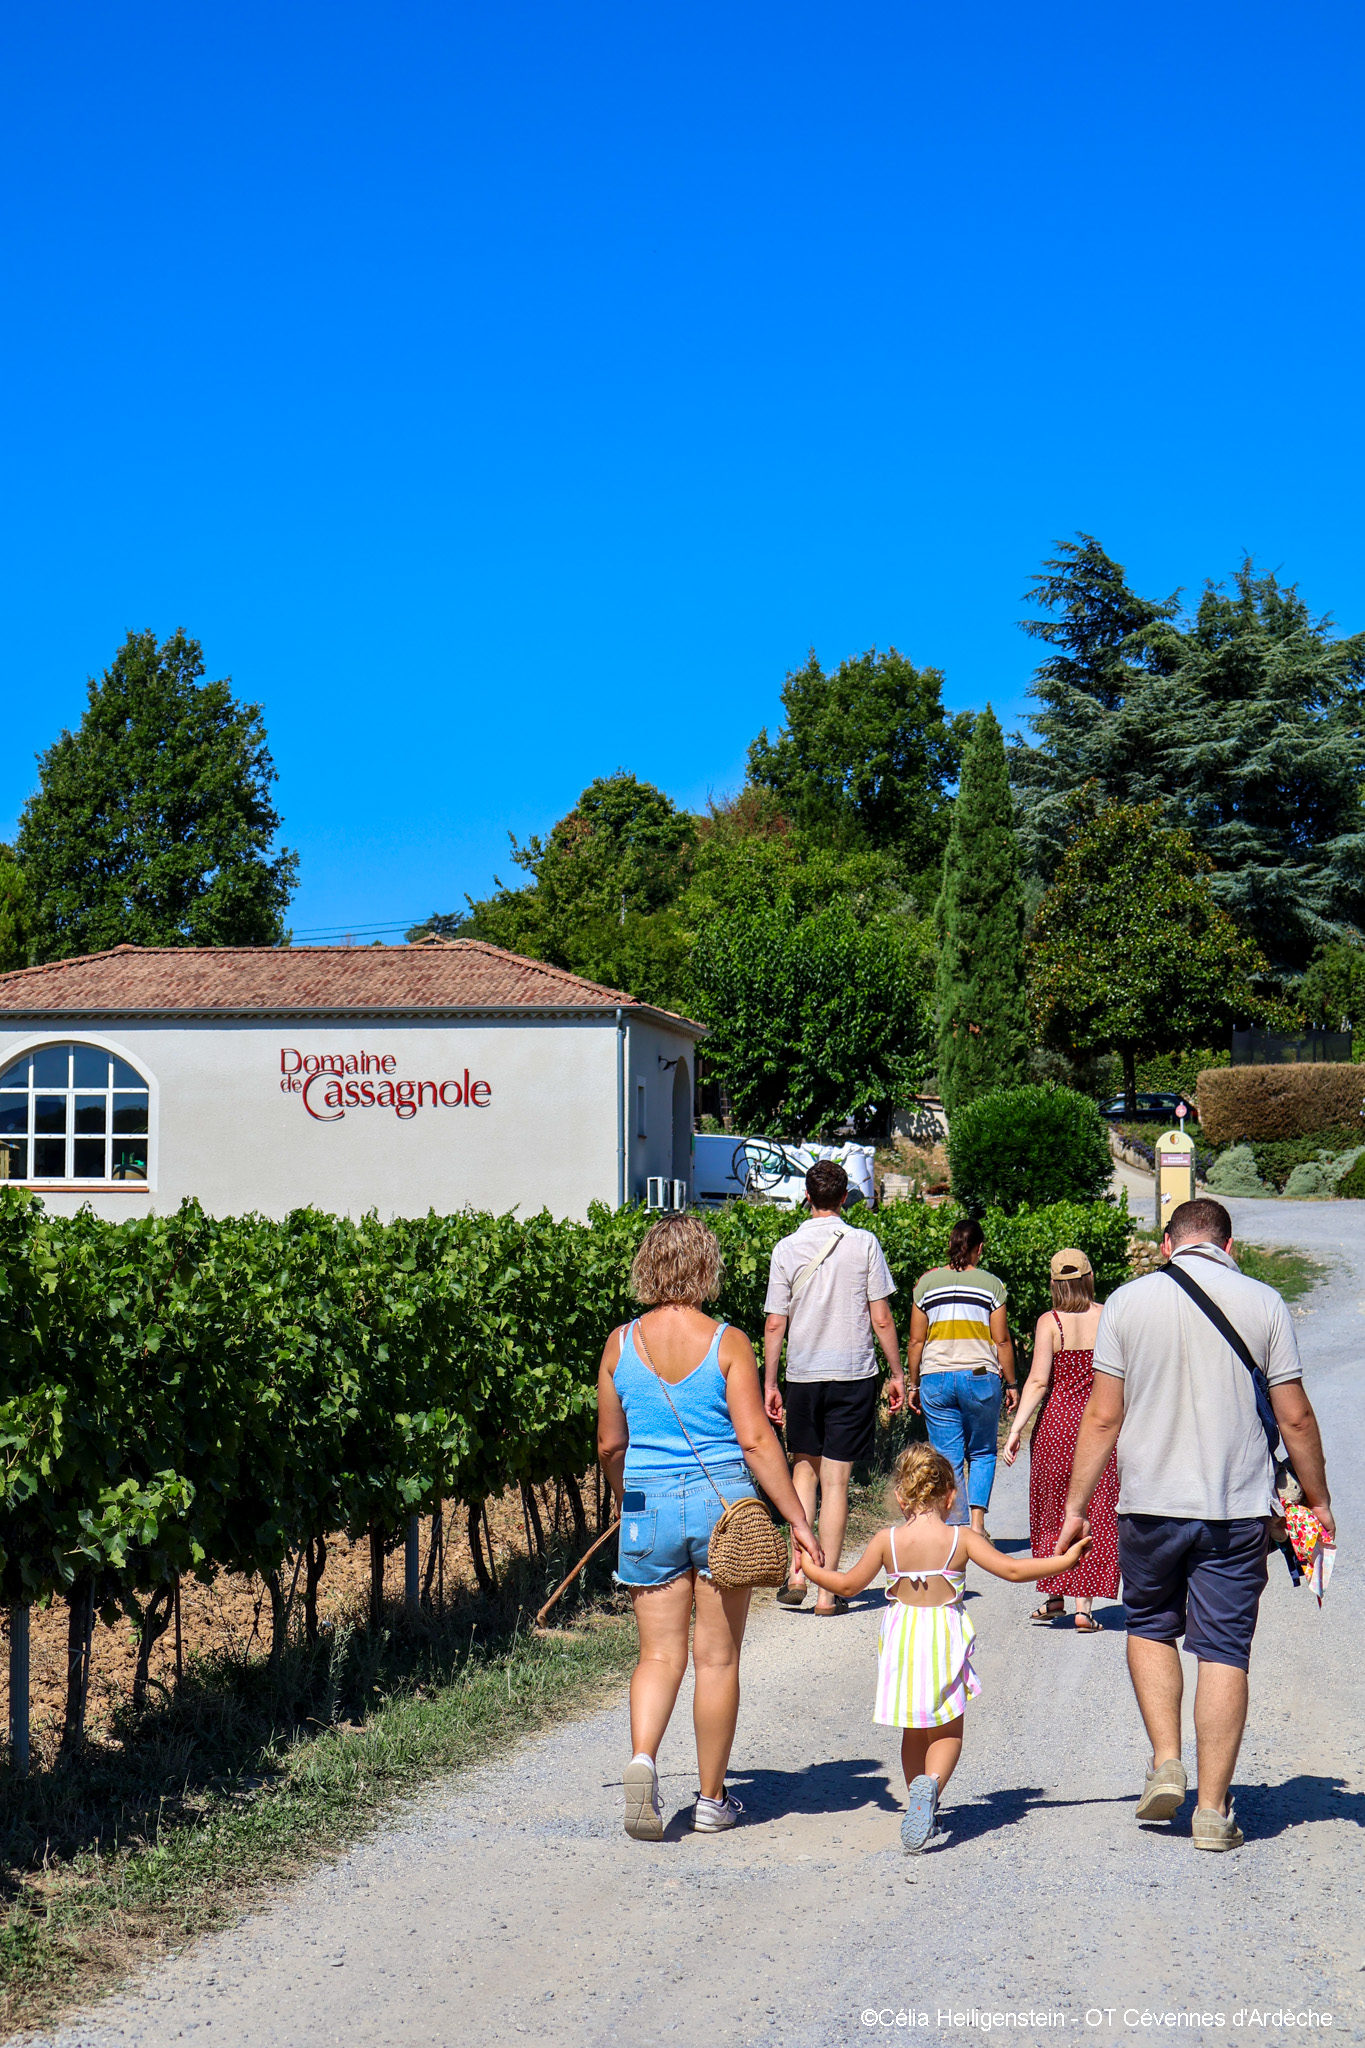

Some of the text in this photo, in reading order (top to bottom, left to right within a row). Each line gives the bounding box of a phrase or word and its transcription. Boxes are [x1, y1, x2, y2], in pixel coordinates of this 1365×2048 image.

[280, 1048, 397, 1074] Domaine
[280, 1068, 492, 1122] de Cassagnole
